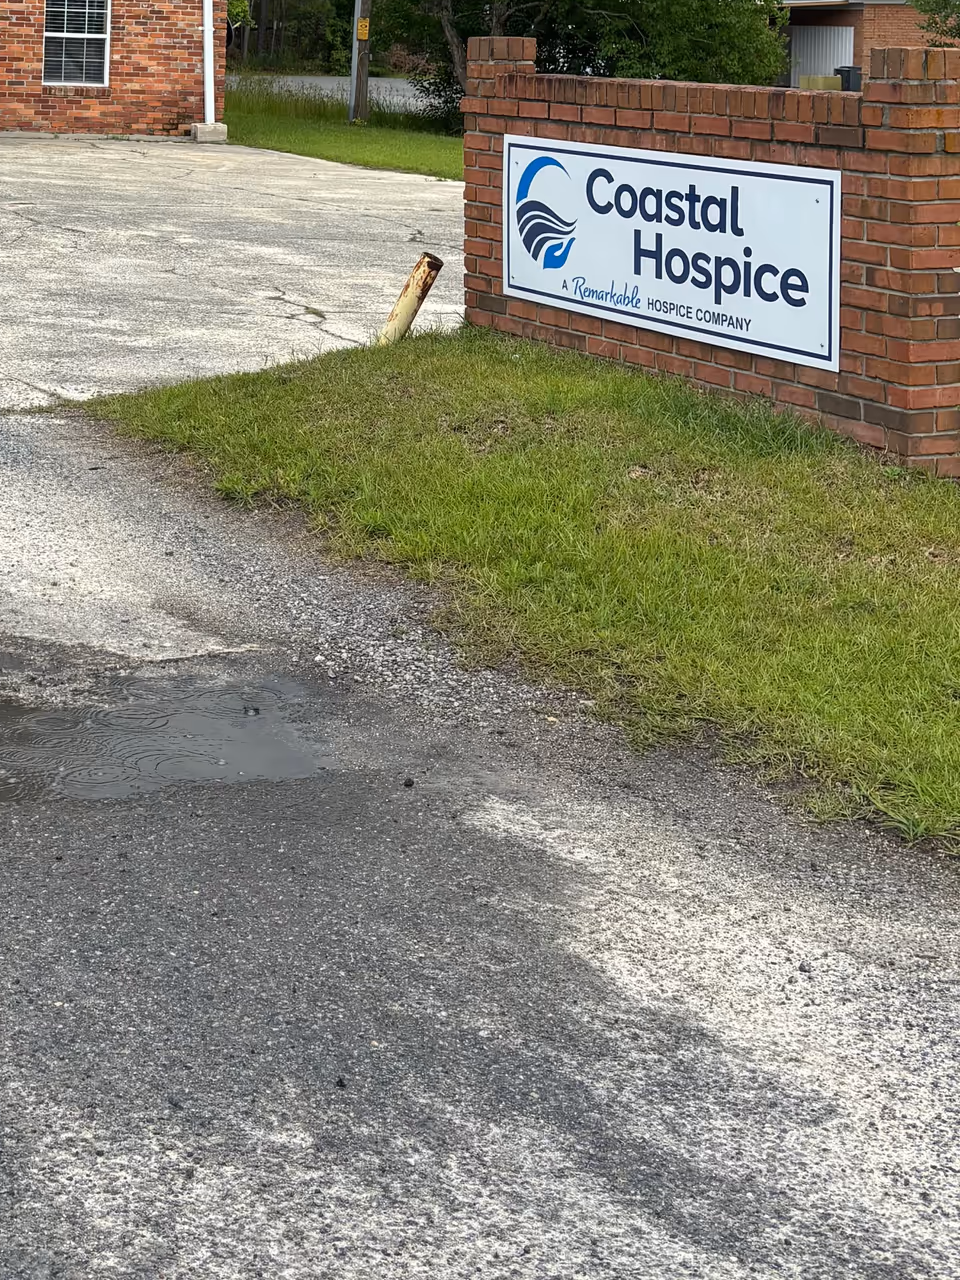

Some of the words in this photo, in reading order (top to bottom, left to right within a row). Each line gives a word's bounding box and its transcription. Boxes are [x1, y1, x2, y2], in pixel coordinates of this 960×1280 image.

[585, 168, 744, 237] Coastal
[633, 229, 810, 307] Hospice
[562, 280, 568, 291] A
[572, 276, 641, 309] Remarkable
[647, 297, 693, 319] HOSPICE
[696, 309, 752, 332] COMPANY
